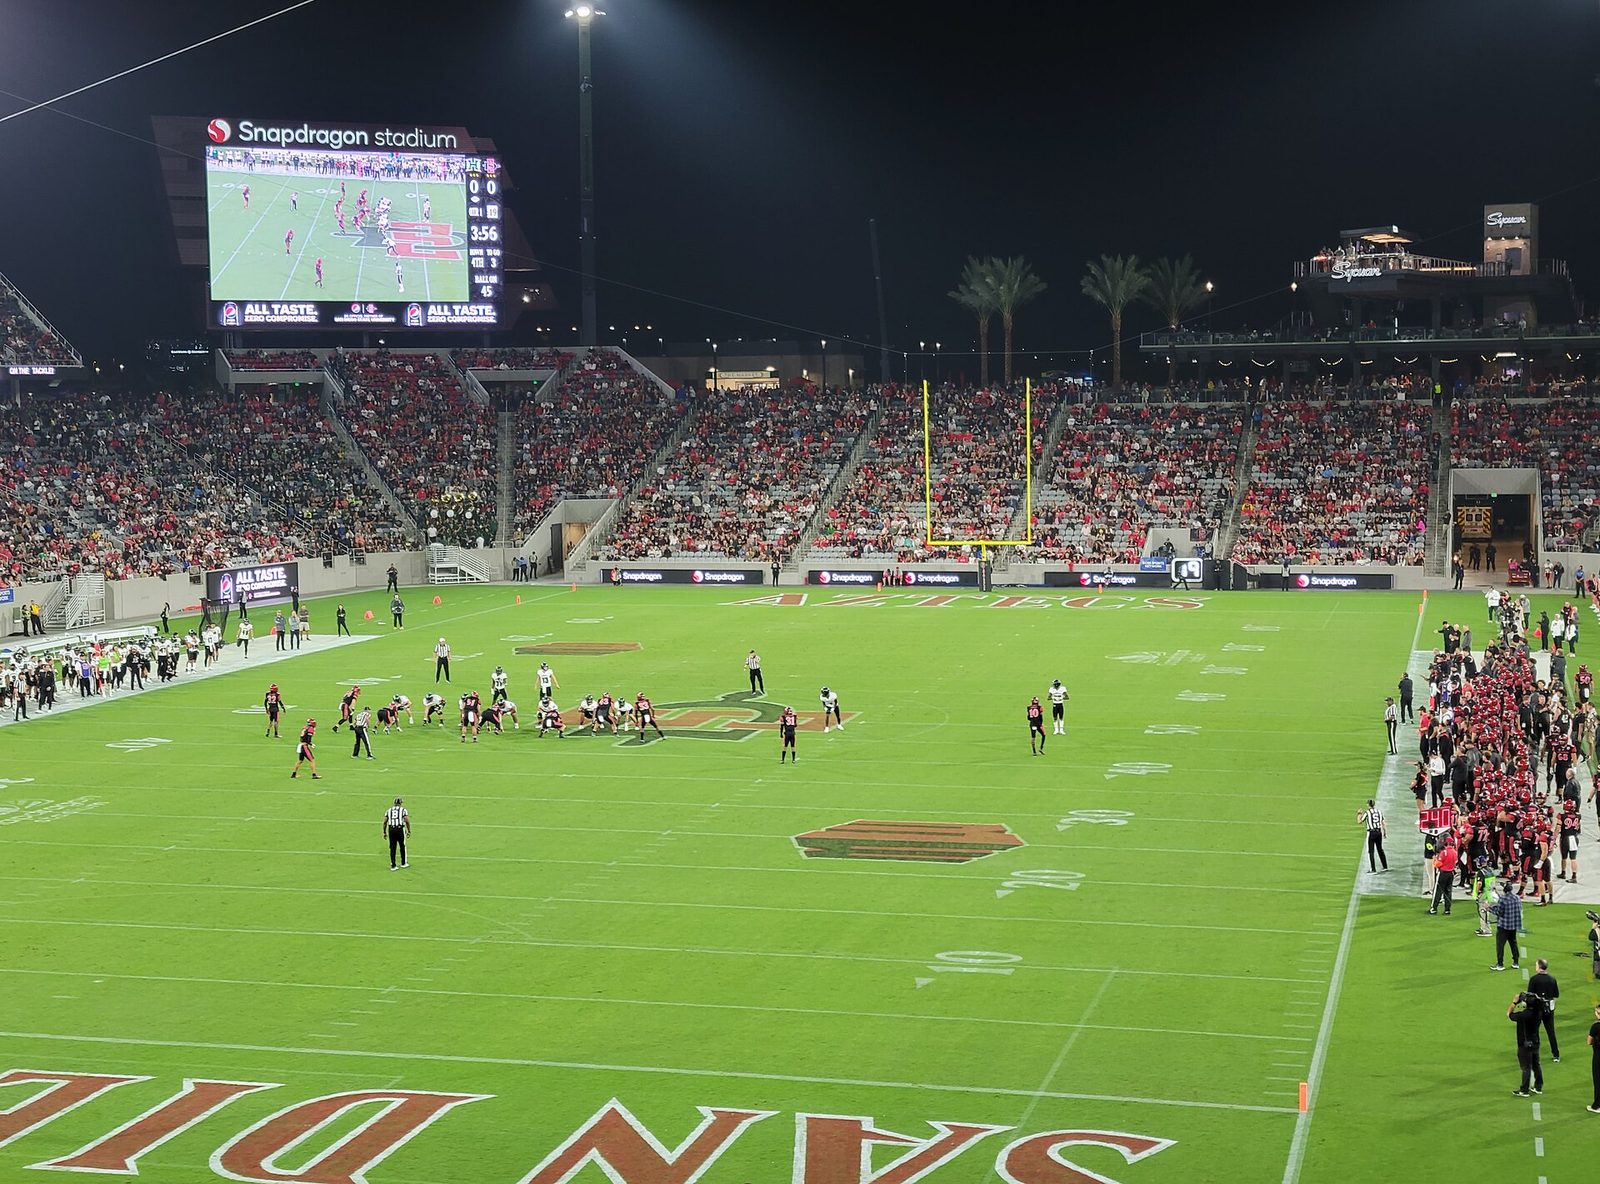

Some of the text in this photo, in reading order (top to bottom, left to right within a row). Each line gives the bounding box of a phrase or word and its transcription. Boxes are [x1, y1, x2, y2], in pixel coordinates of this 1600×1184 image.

[239, 121, 457, 149] Snapdragon stadium
[469, 180, 496, 195] 0 0
[1487, 211, 1527, 228] Sycuan
[470, 225, 498, 241] 3:56
[471, 257, 497, 268] 4TH 3
[1331, 261, 1382, 283] Sycuan
[481, 286, 493, 297] 45
[244, 304, 318, 316] ALL TASTE.
[427, 305, 496, 317] ALL TASTE.
[266, 315, 318, 323] COMPROMISE.
[1181, 561, 1200, 578] 19
[236, 567, 287, 585] ALL TASTE.
[623, 572, 662, 581] Snapdragon
[705, 572, 745, 581] Snapdragon
[832, 573, 873, 582] Snapdragon
[917, 574, 959, 583] Snapdragon
[1093, 575, 1136, 585] Sndragon
[1311, 576, 1357, 586] Snapdragon
[718, 593, 1210, 608] AZTECS
[1029, 709, 1039, 717] 10
[785, 716, 795, 725] 31
[391, 810, 398, 819] B
[1059, 810, 1136, 826] 30
[1373, 813, 1380, 823] S
[1420, 807, 1451, 830] 240
[1564, 817, 1579, 830] 94
[1001, 869, 1086, 891] 20
[926, 950, 1023, 976] 10
